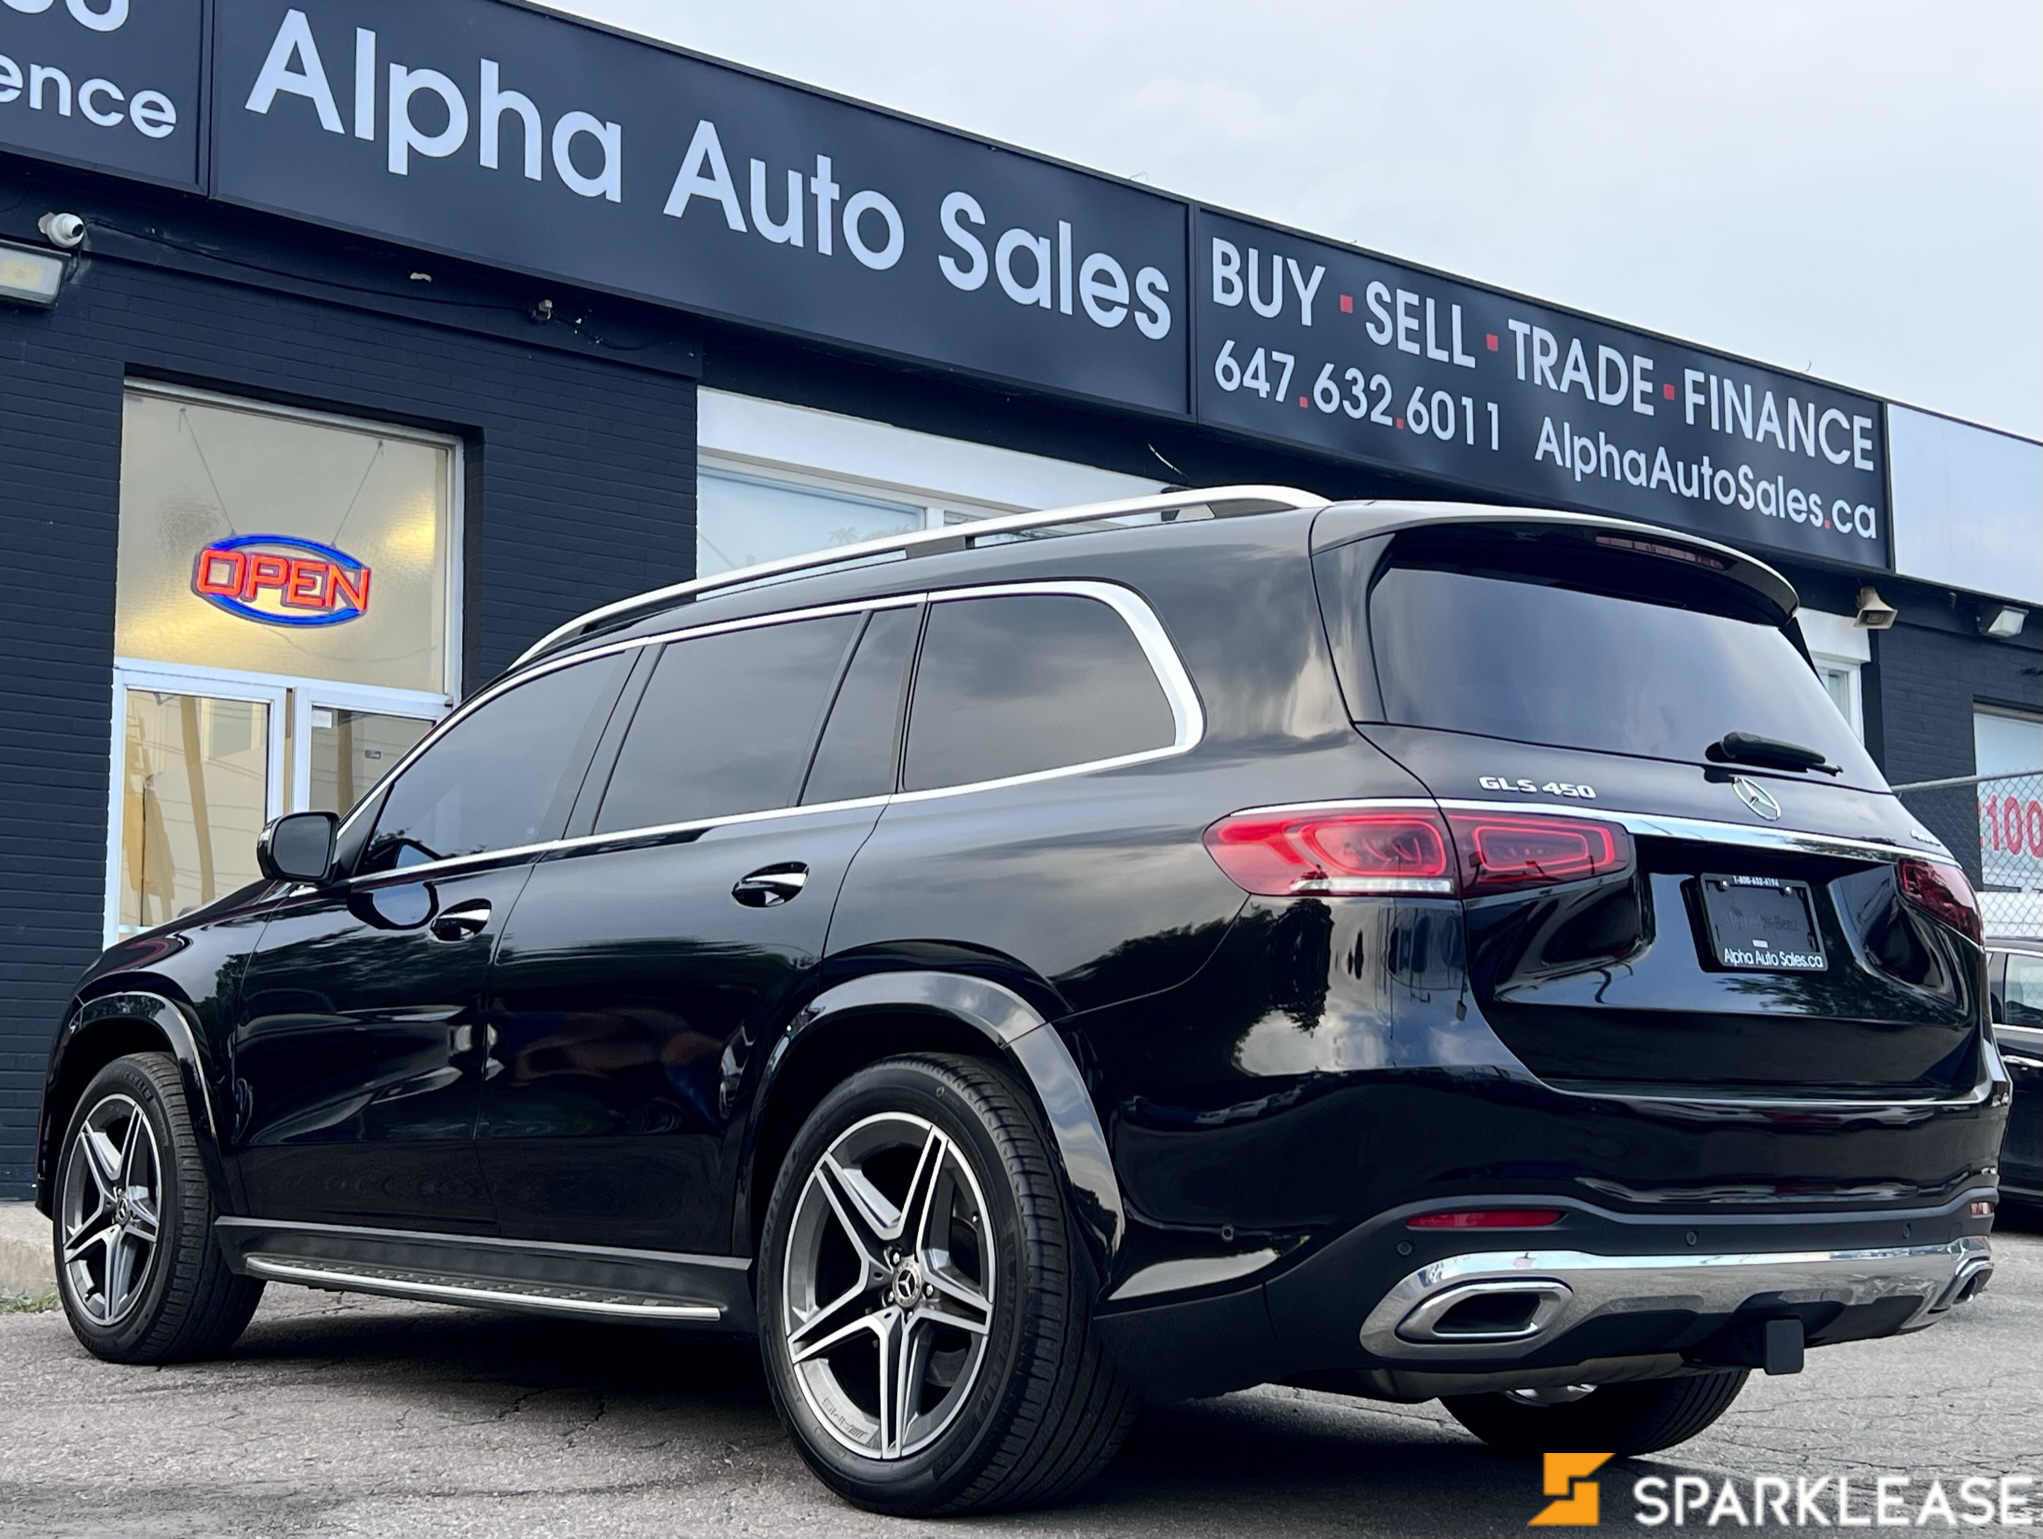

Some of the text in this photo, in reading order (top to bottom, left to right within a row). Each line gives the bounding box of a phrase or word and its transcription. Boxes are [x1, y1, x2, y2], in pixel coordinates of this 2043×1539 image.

[244, 8, 1172, 340] Alpha Auto Sales
[1212, 236, 1874, 472] BUY SELL TRADE FINANCE
[1214, 339, 1499, 451] 647.632.6011
[1534, 416, 1877, 539] AlphaAutoSales.ca
[198, 547, 372, 613] OPEN
[1478, 775, 1598, 799] GLS 450
[1724, 947, 1824, 969] Alpha Auto Sales.ca
